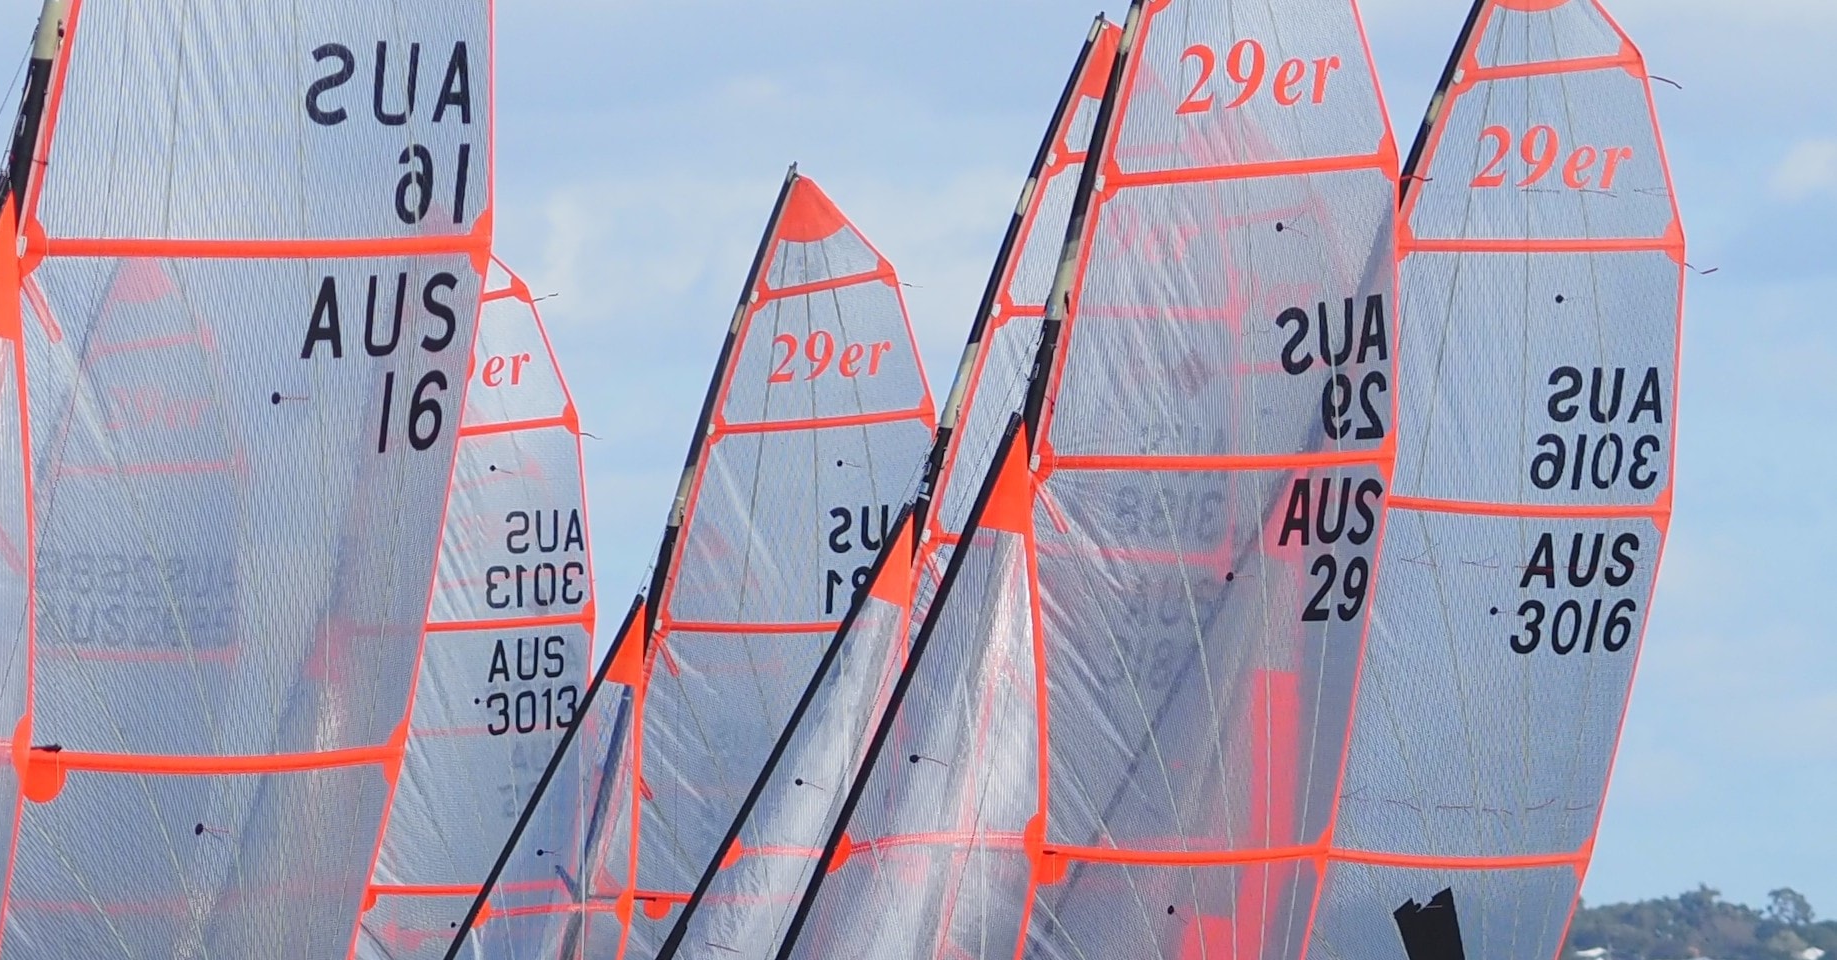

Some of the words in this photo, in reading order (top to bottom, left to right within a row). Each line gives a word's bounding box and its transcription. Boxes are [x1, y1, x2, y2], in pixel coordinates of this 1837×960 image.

[1175, 38, 1341, 115] 29er
[1469, 123, 1633, 189] 29er
[300, 272, 458, 359] AUS
[482, 353, 531, 387] er
[767, 330, 893, 383] 29er
[377, 369, 448, 453] 16
[1278, 478, 1383, 546] AUS
[1301, 554, 1370, 622] 29
[1519, 533, 1640, 589] AUS
[1510, 599, 1637, 655] 3016
[488, 636, 565, 683] AUS
[486, 685, 578, 736] 3013
